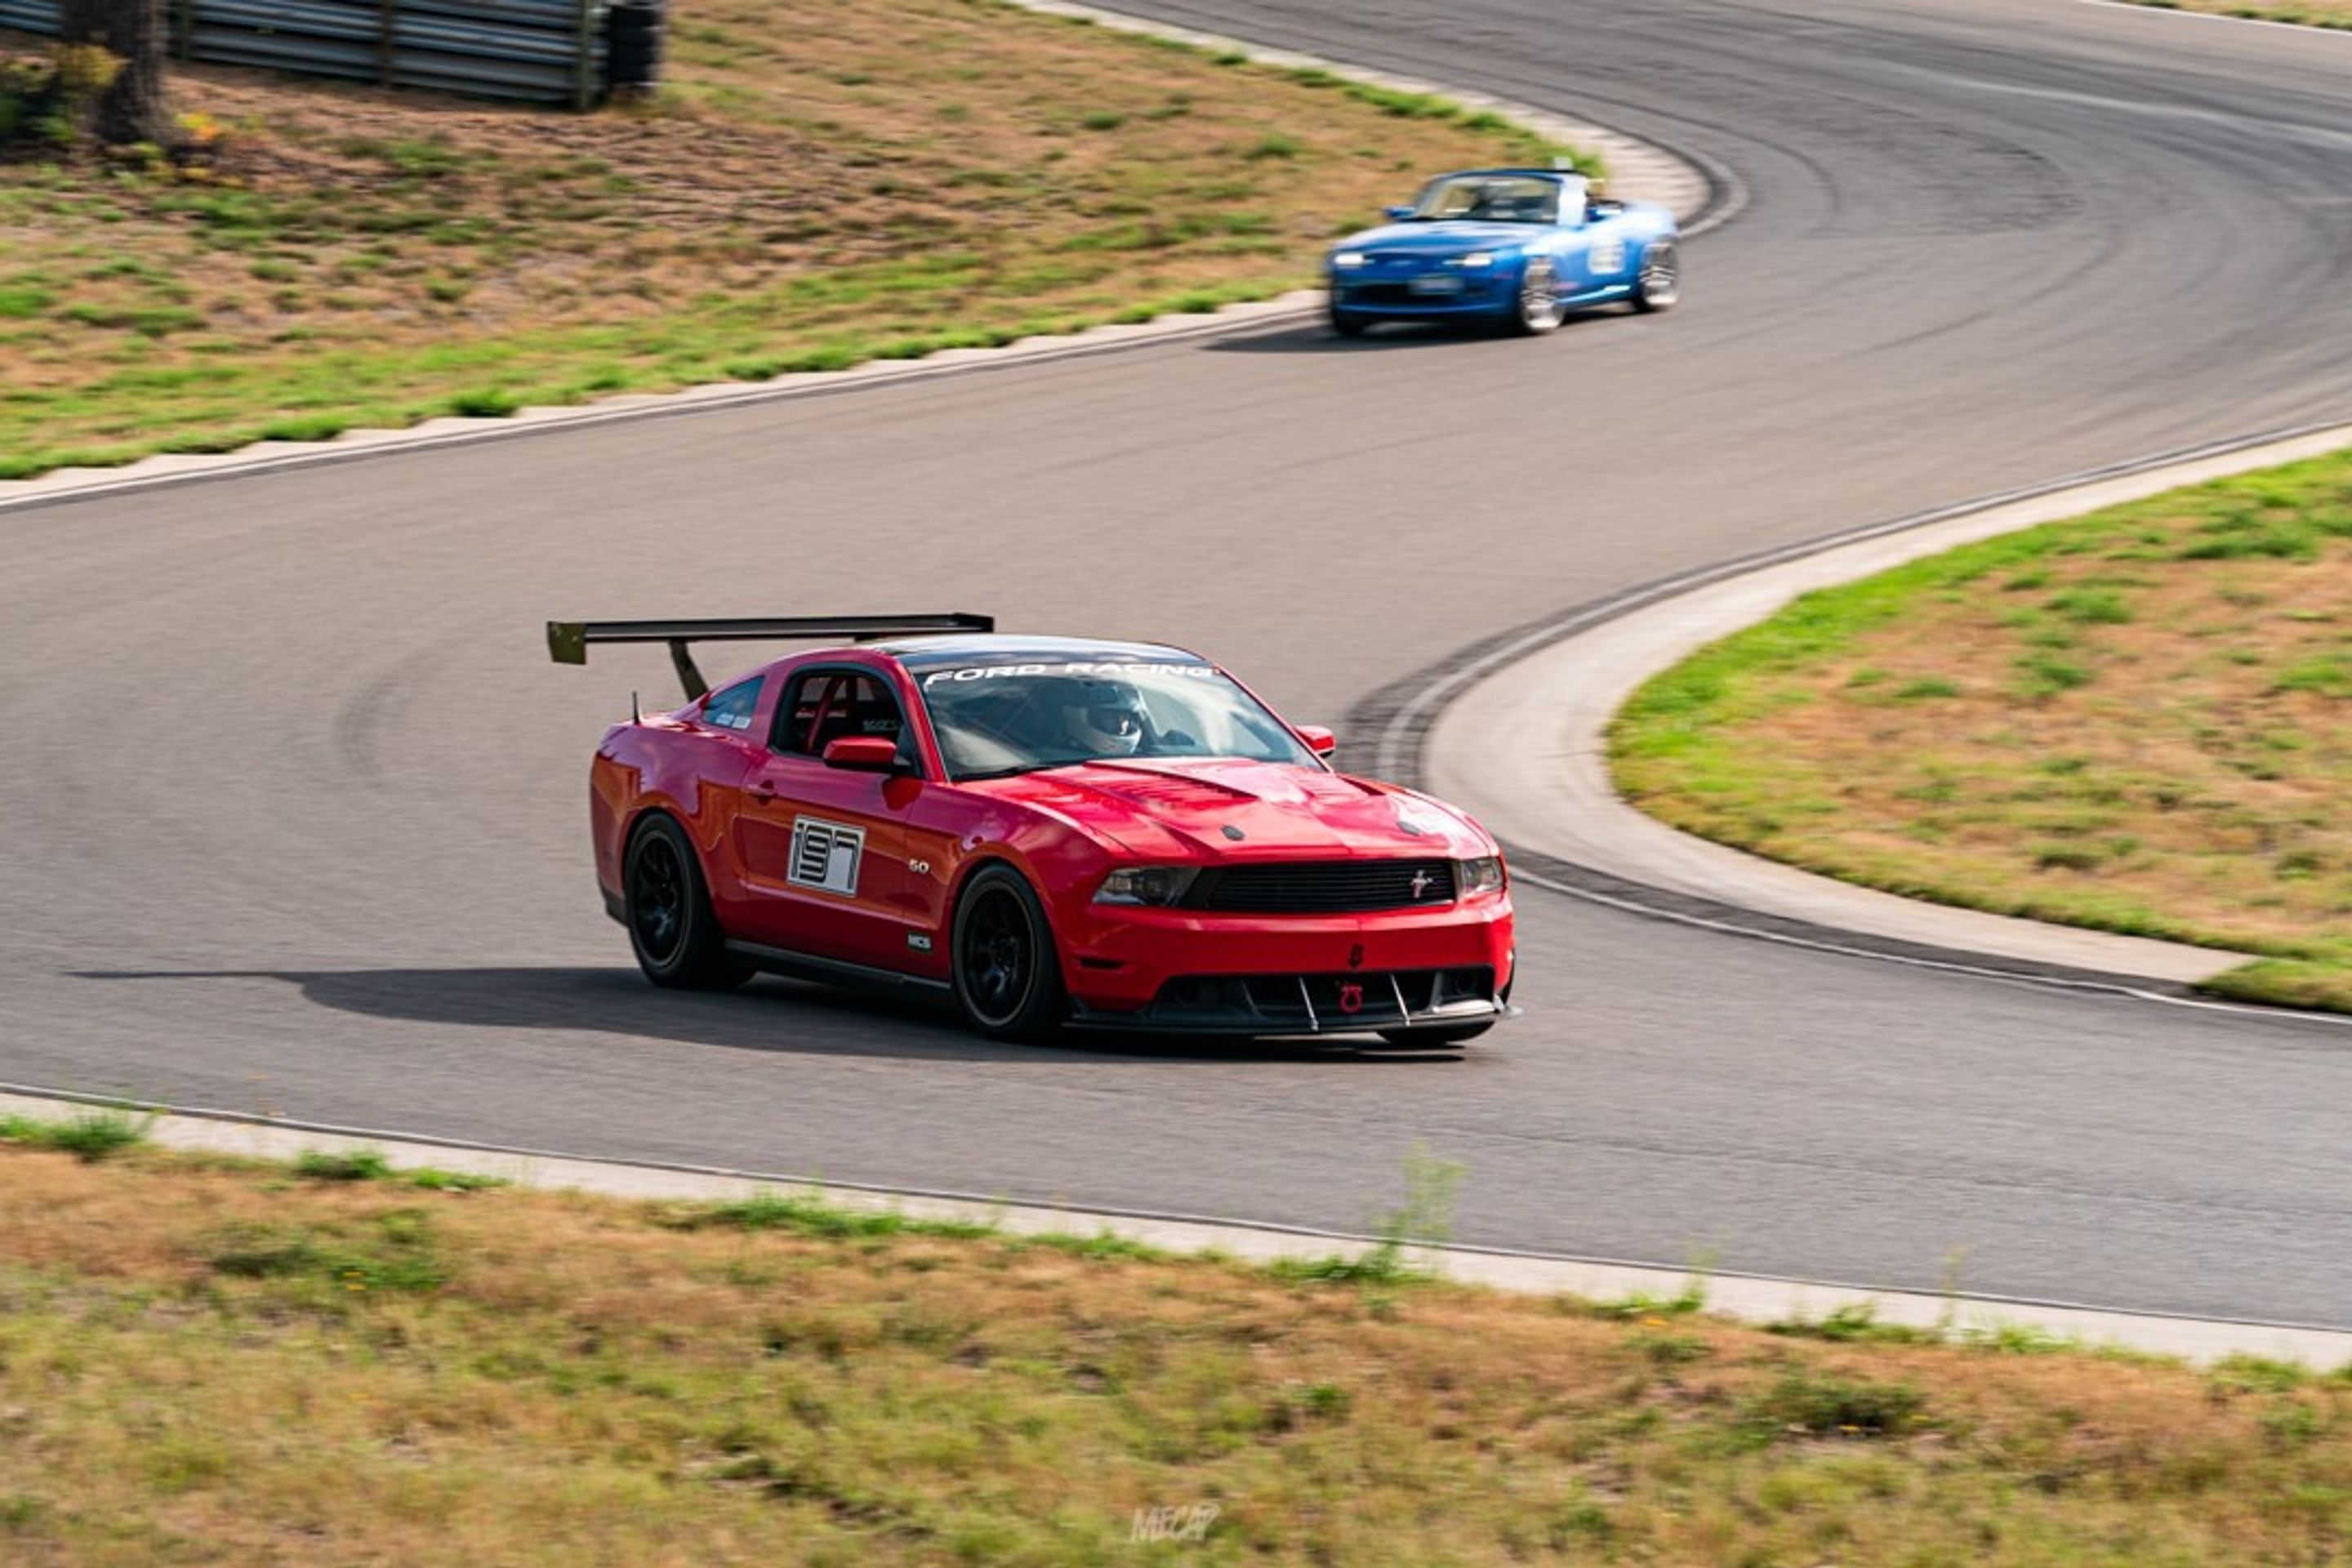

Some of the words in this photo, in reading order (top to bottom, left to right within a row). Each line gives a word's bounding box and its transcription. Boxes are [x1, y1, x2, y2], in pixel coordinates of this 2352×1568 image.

[924, 664, 1046, 693] FORD
[1065, 662, 1213, 677] RACING
[791, 822, 860, 890] 197
